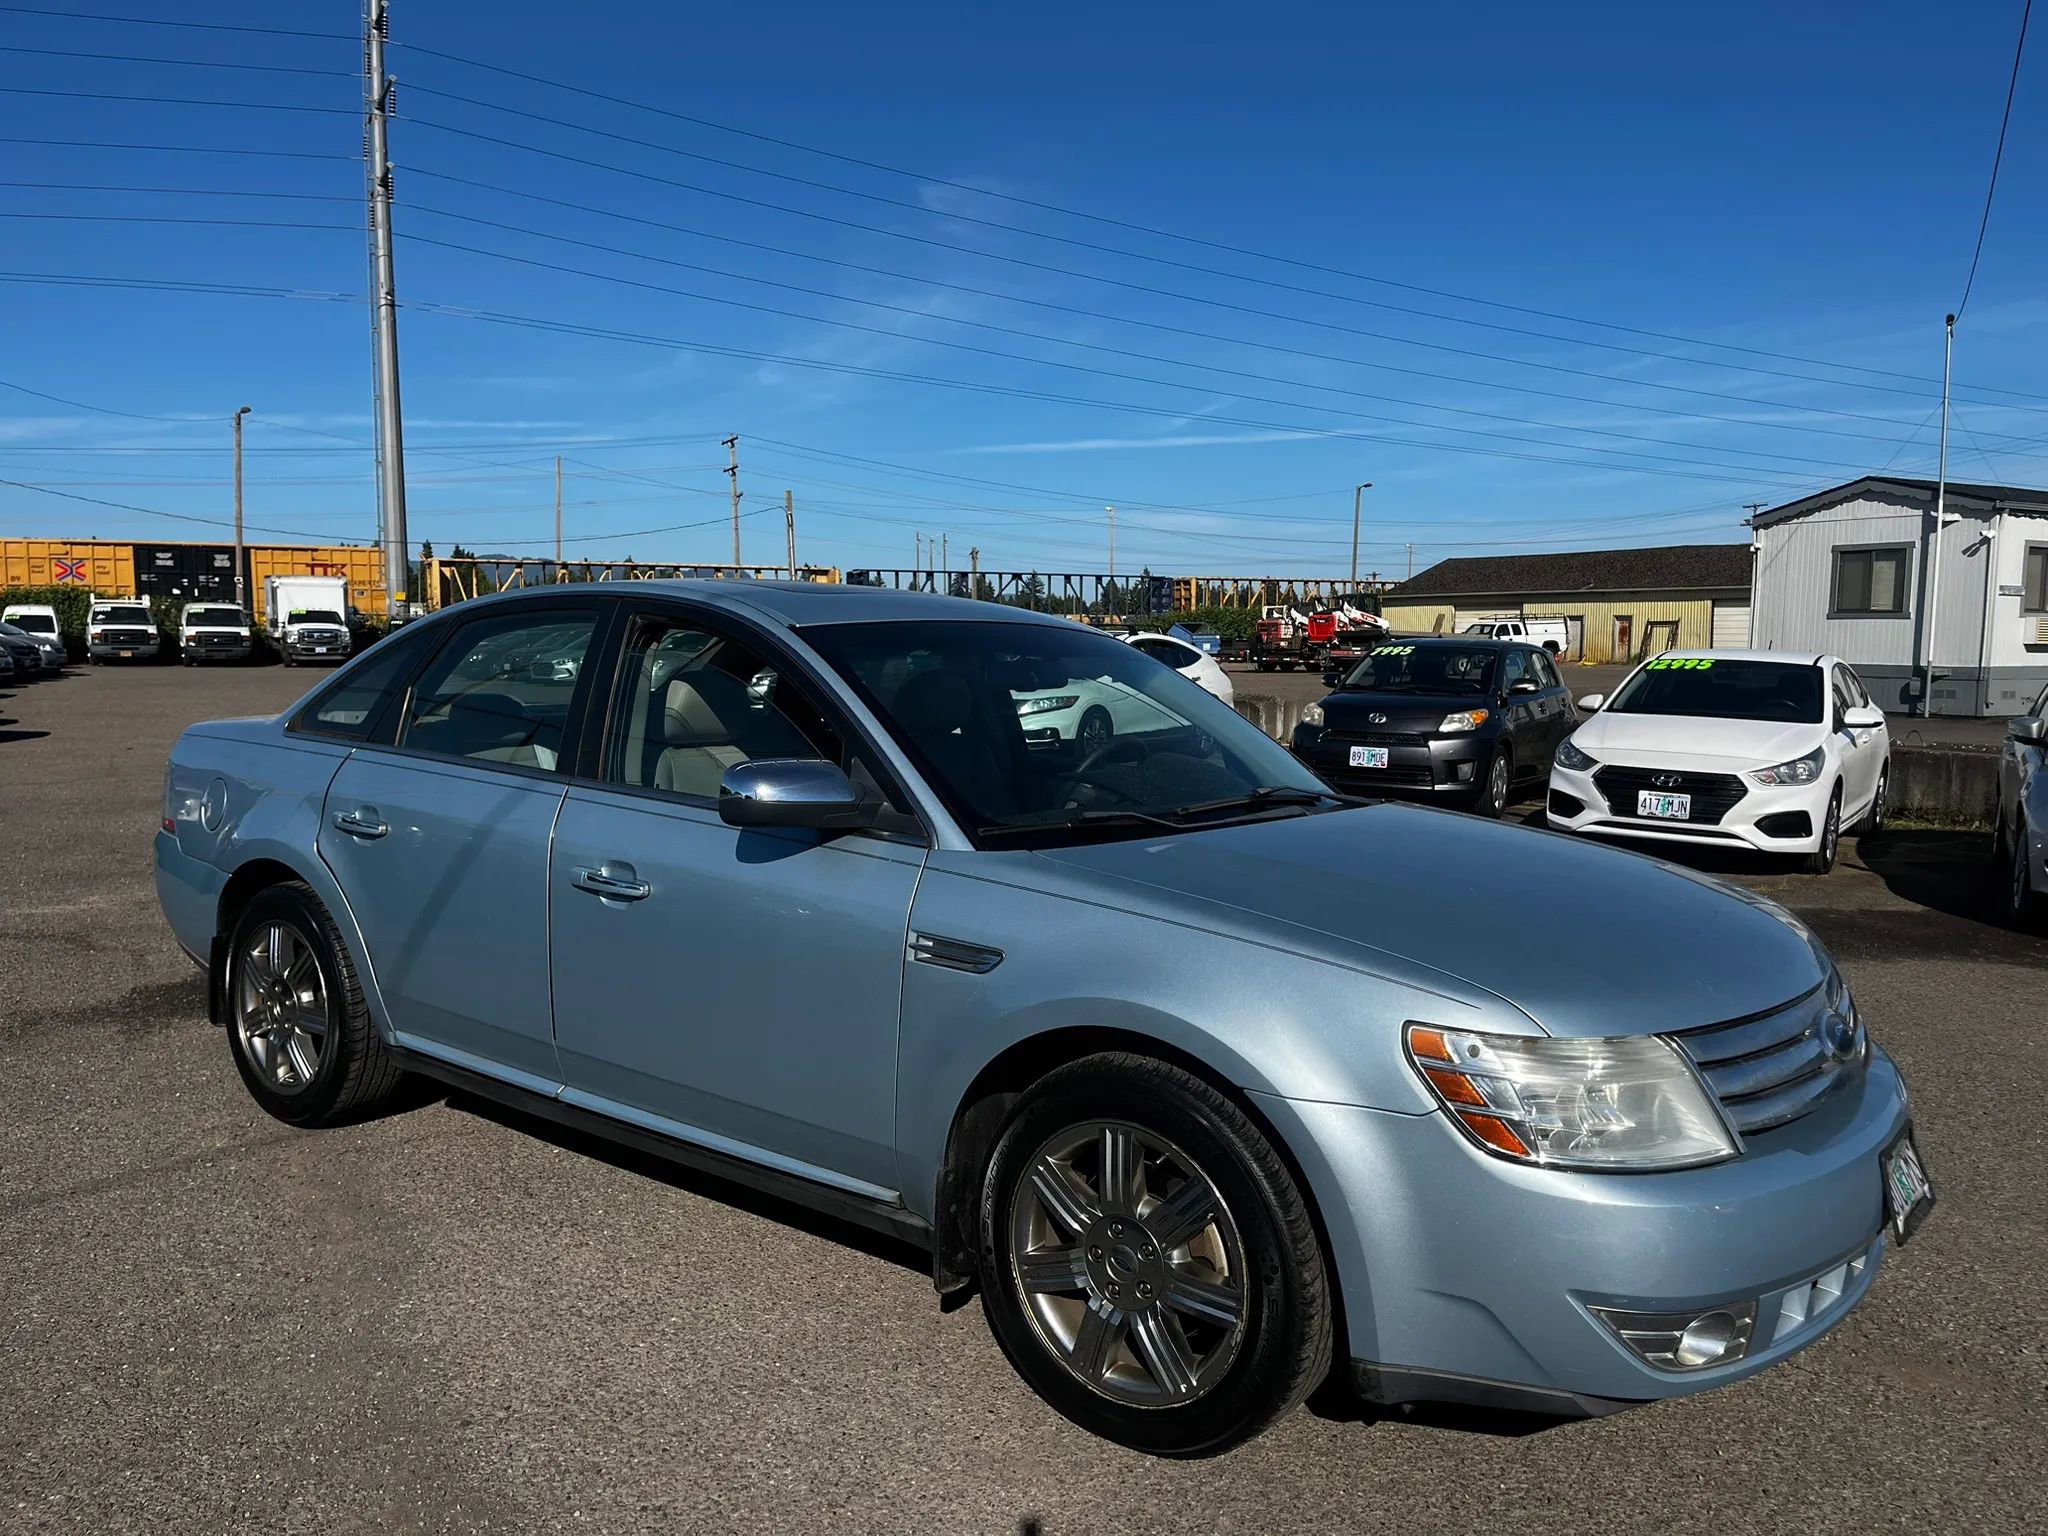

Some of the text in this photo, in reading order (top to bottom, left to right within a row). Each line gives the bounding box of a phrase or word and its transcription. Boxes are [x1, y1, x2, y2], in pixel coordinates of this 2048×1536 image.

[305, 563, 347, 577] TTX
[1645, 659, 1716, 670] 12995
[1351, 751, 1366, 764] 891
[1640, 796, 1688, 813] 417 MJN
